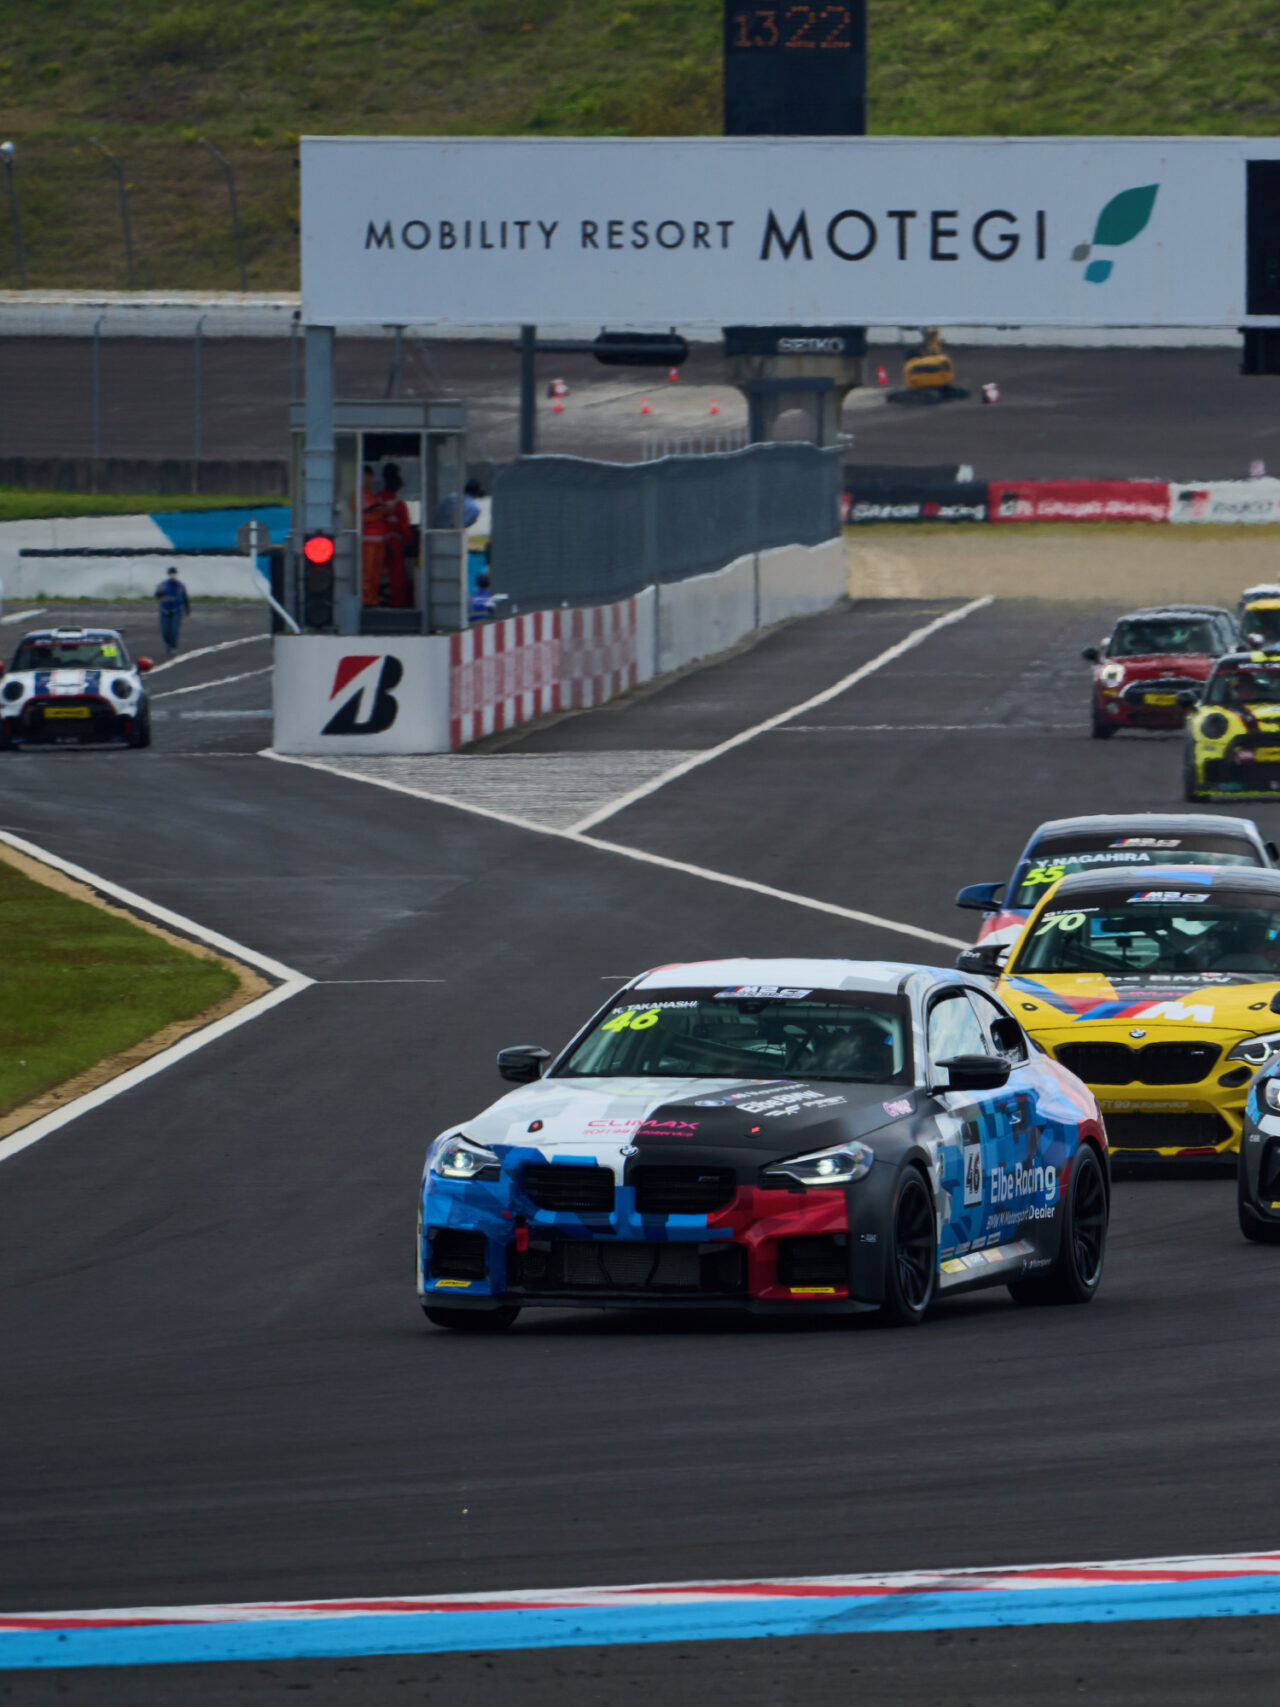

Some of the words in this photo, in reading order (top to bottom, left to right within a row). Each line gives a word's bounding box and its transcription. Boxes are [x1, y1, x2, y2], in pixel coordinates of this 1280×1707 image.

[365, 221, 559, 250] MOBILITY
[581, 221, 735, 250] RESORT
[760, 210, 1047, 262] MOTEGI
[1021, 865, 1066, 887] 55
[1033, 912, 1087, 936] 70
[601, 1008, 662, 1032] 46
[965, 1152, 981, 1195] 46
[990, 1168, 1014, 1205] Elbe
[1015, 1158, 1057, 1201] Racing
[1028, 1203, 1056, 1220] Dealer
